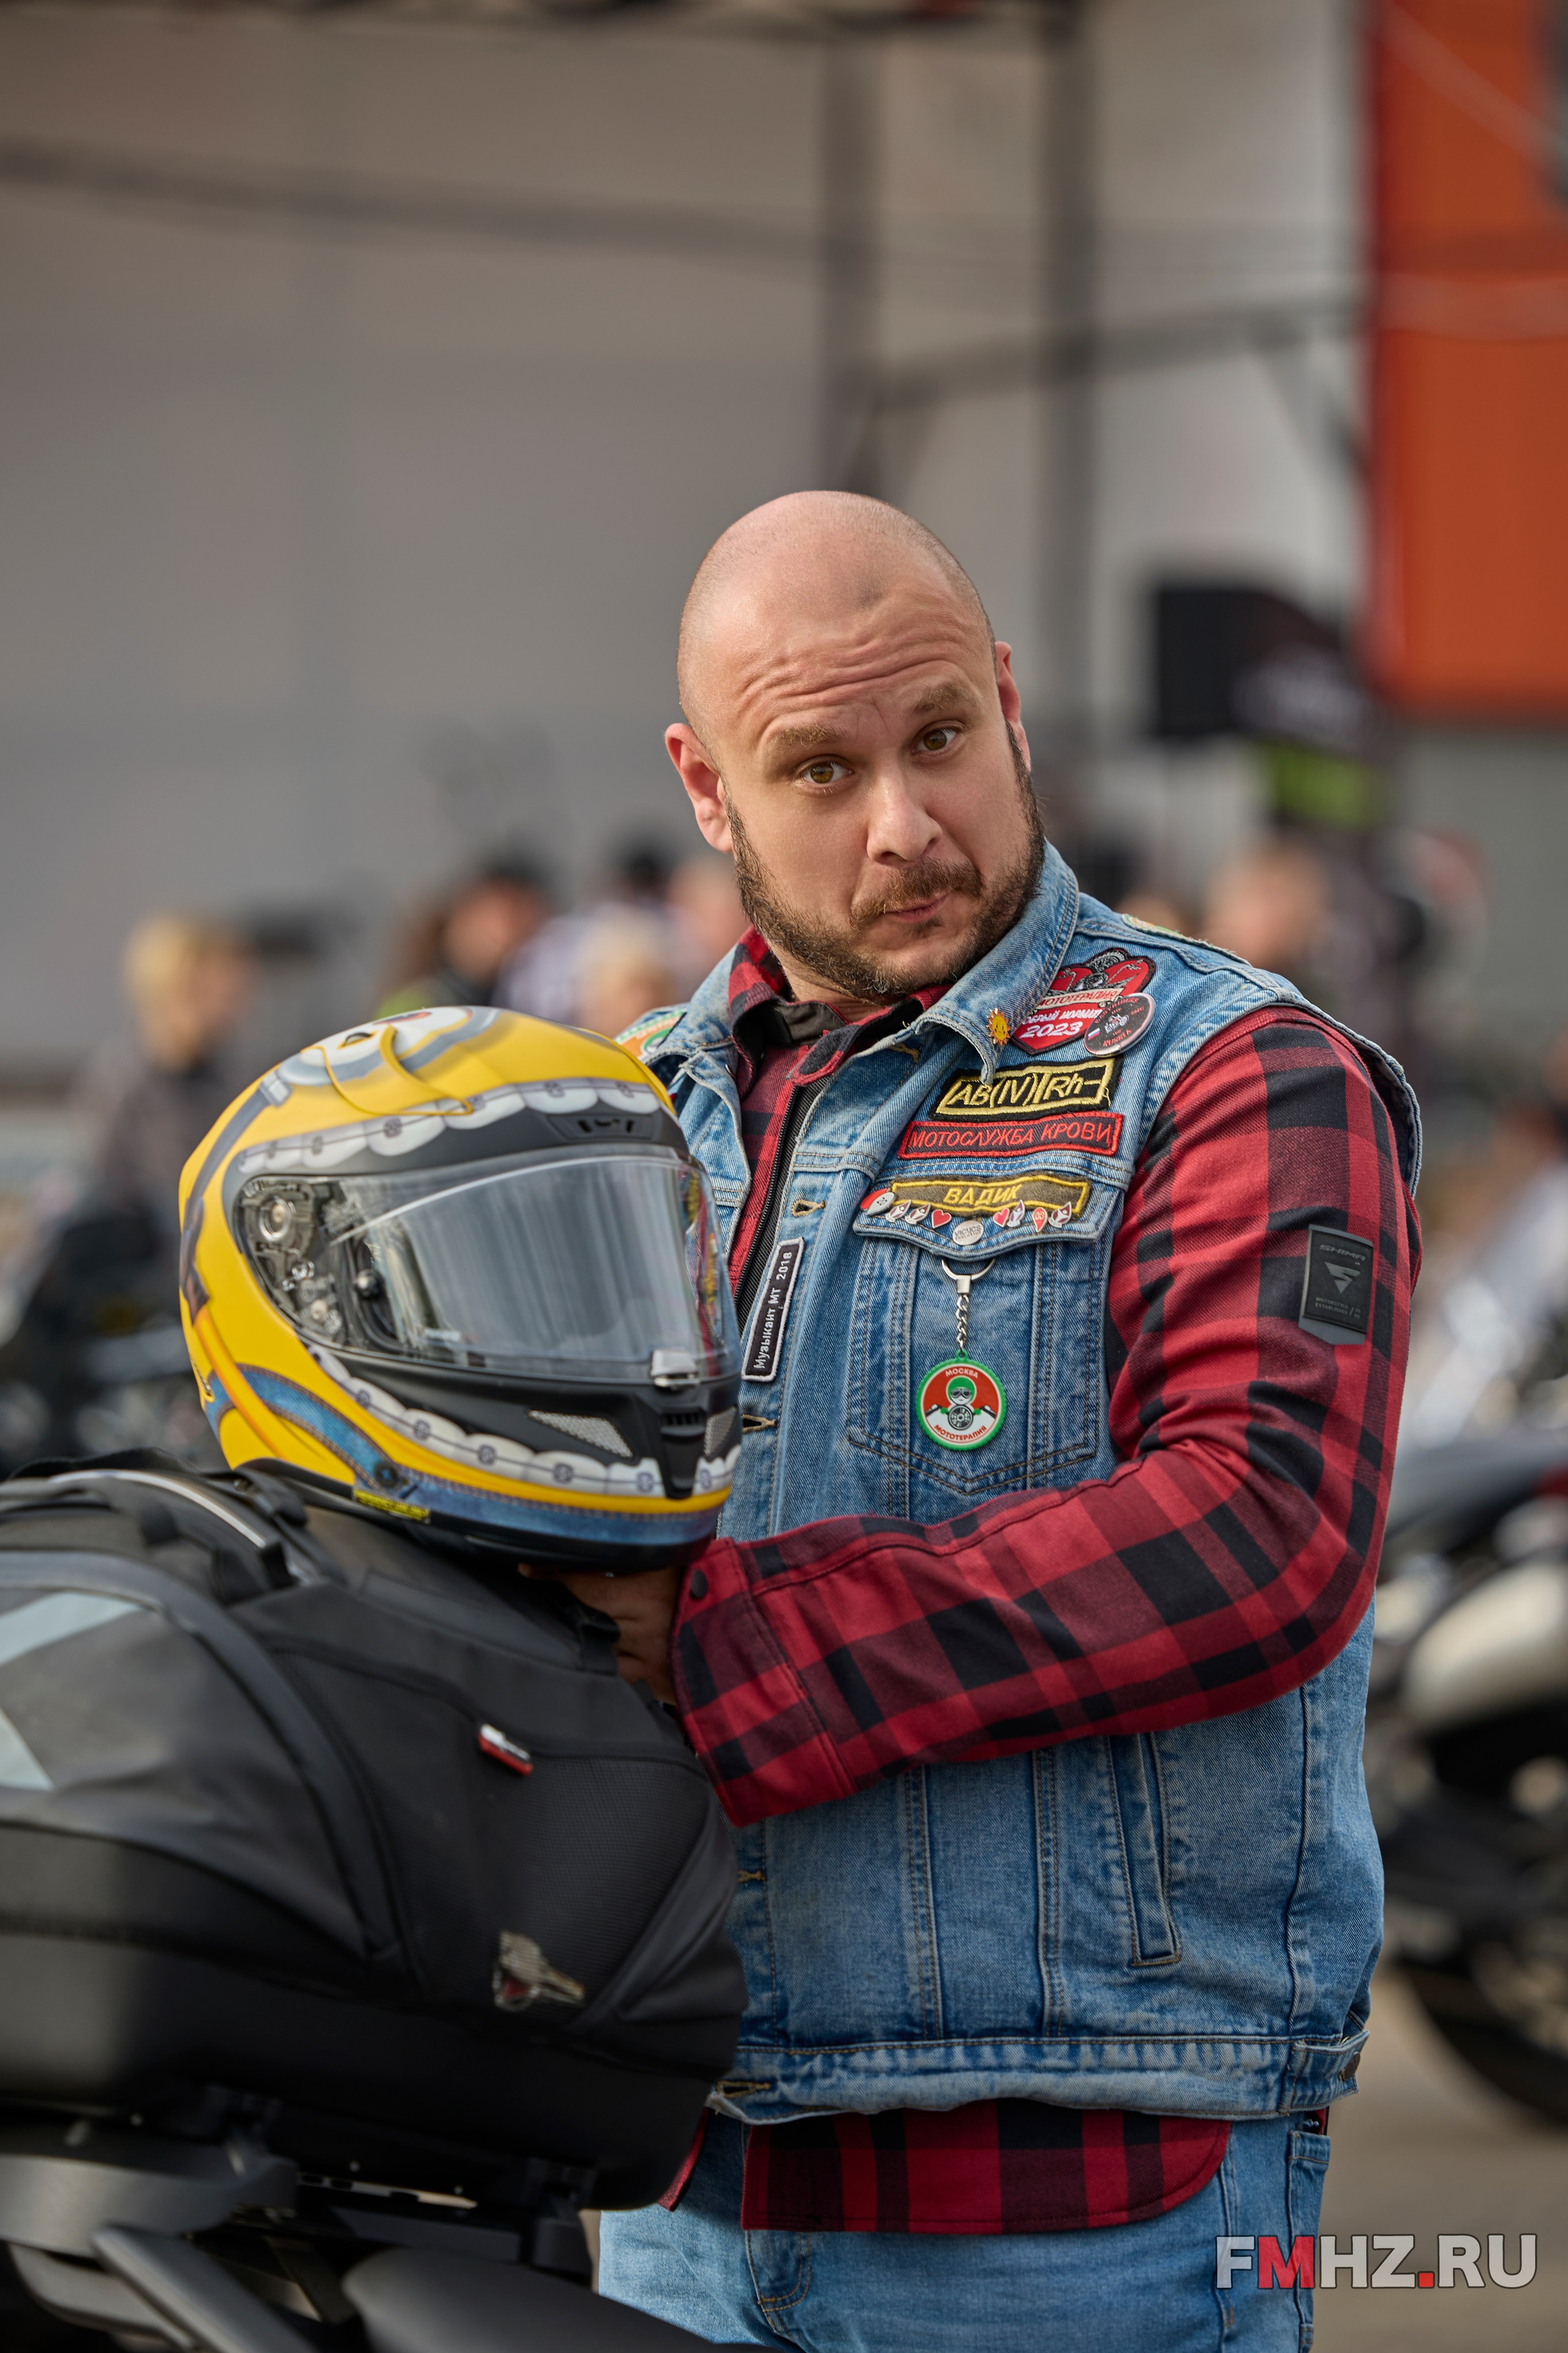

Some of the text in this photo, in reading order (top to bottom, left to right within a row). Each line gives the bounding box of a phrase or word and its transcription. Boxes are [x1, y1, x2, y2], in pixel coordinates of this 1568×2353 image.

[1019, 1021, 1083, 1038] 2023
[908, 1122, 1111, 1148] МОТОСЛУЖБА КРОВИ
[943, 1184, 1022, 1206] ВАДИК
[753, 1251, 793, 1369] Музыкант МТ 2018
[945, 1368, 979, 1378] МОСКВА
[934, 1424, 987, 1441] МОТОТЕРАПИЯ
